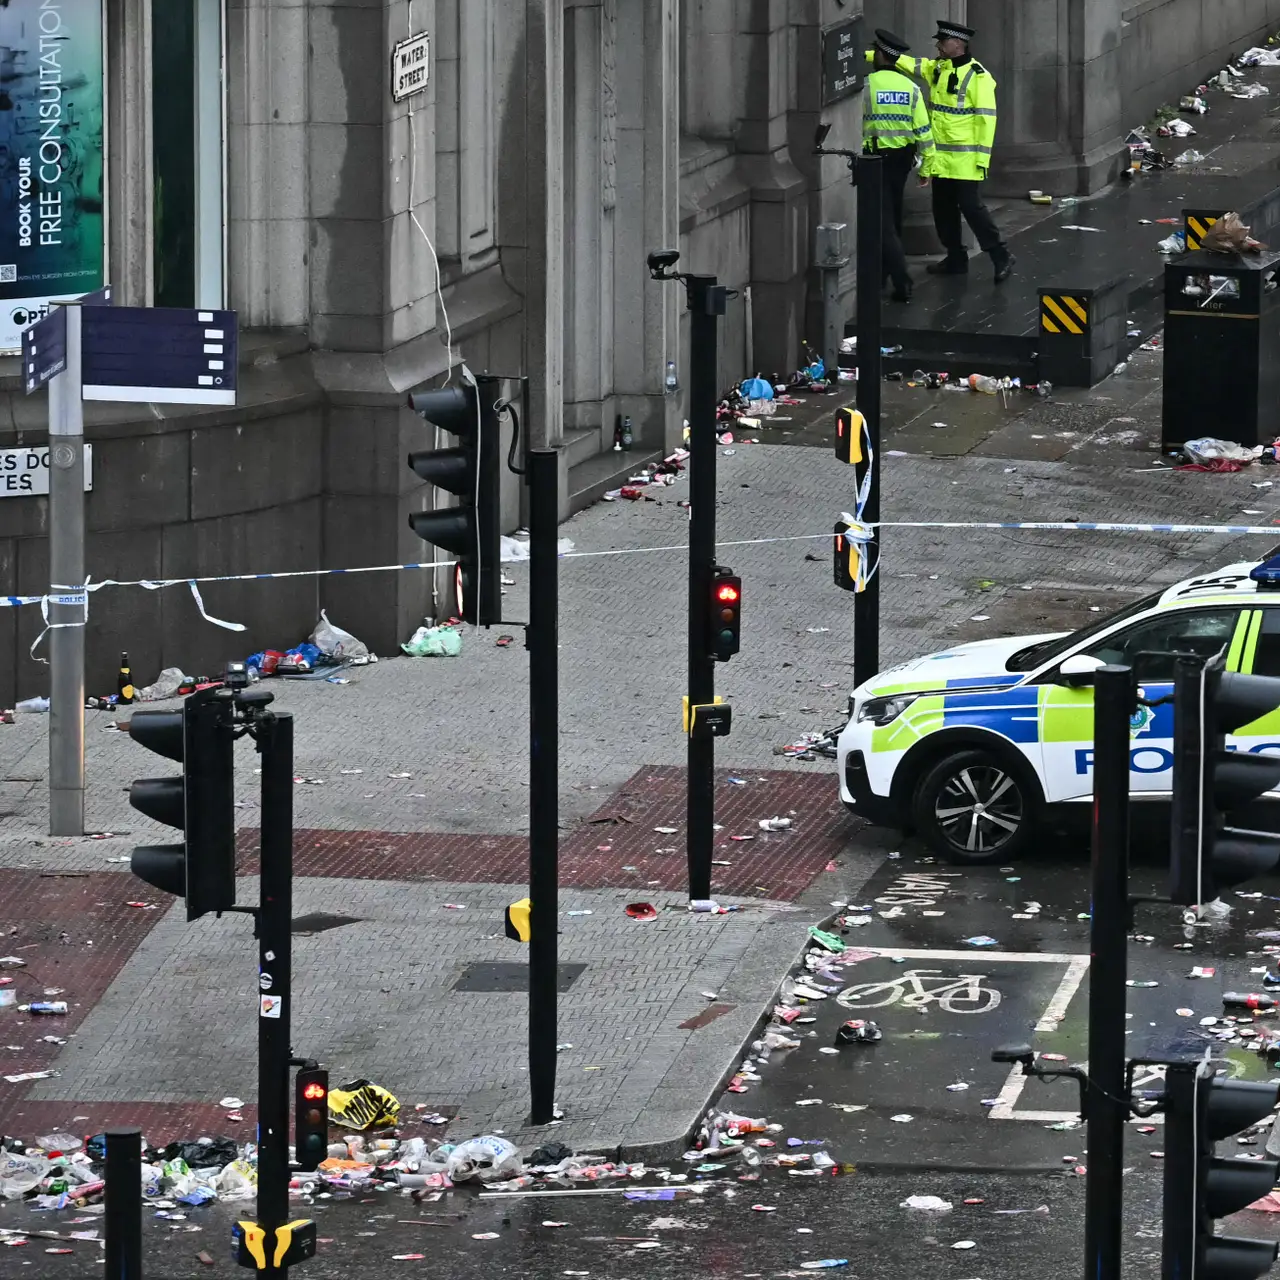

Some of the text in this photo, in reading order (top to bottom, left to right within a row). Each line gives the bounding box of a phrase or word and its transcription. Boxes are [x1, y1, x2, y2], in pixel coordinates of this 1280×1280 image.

[401, 45, 424, 68] WATER
[399, 66, 426, 90] STREET
[877, 93, 909, 104] POLICE
[19, 157, 31, 246] BOOK YOUR
[39, 191, 62, 246] FREE
[10, 306, 49, 325] OPT
[59, 595, 85, 603] POLIC
